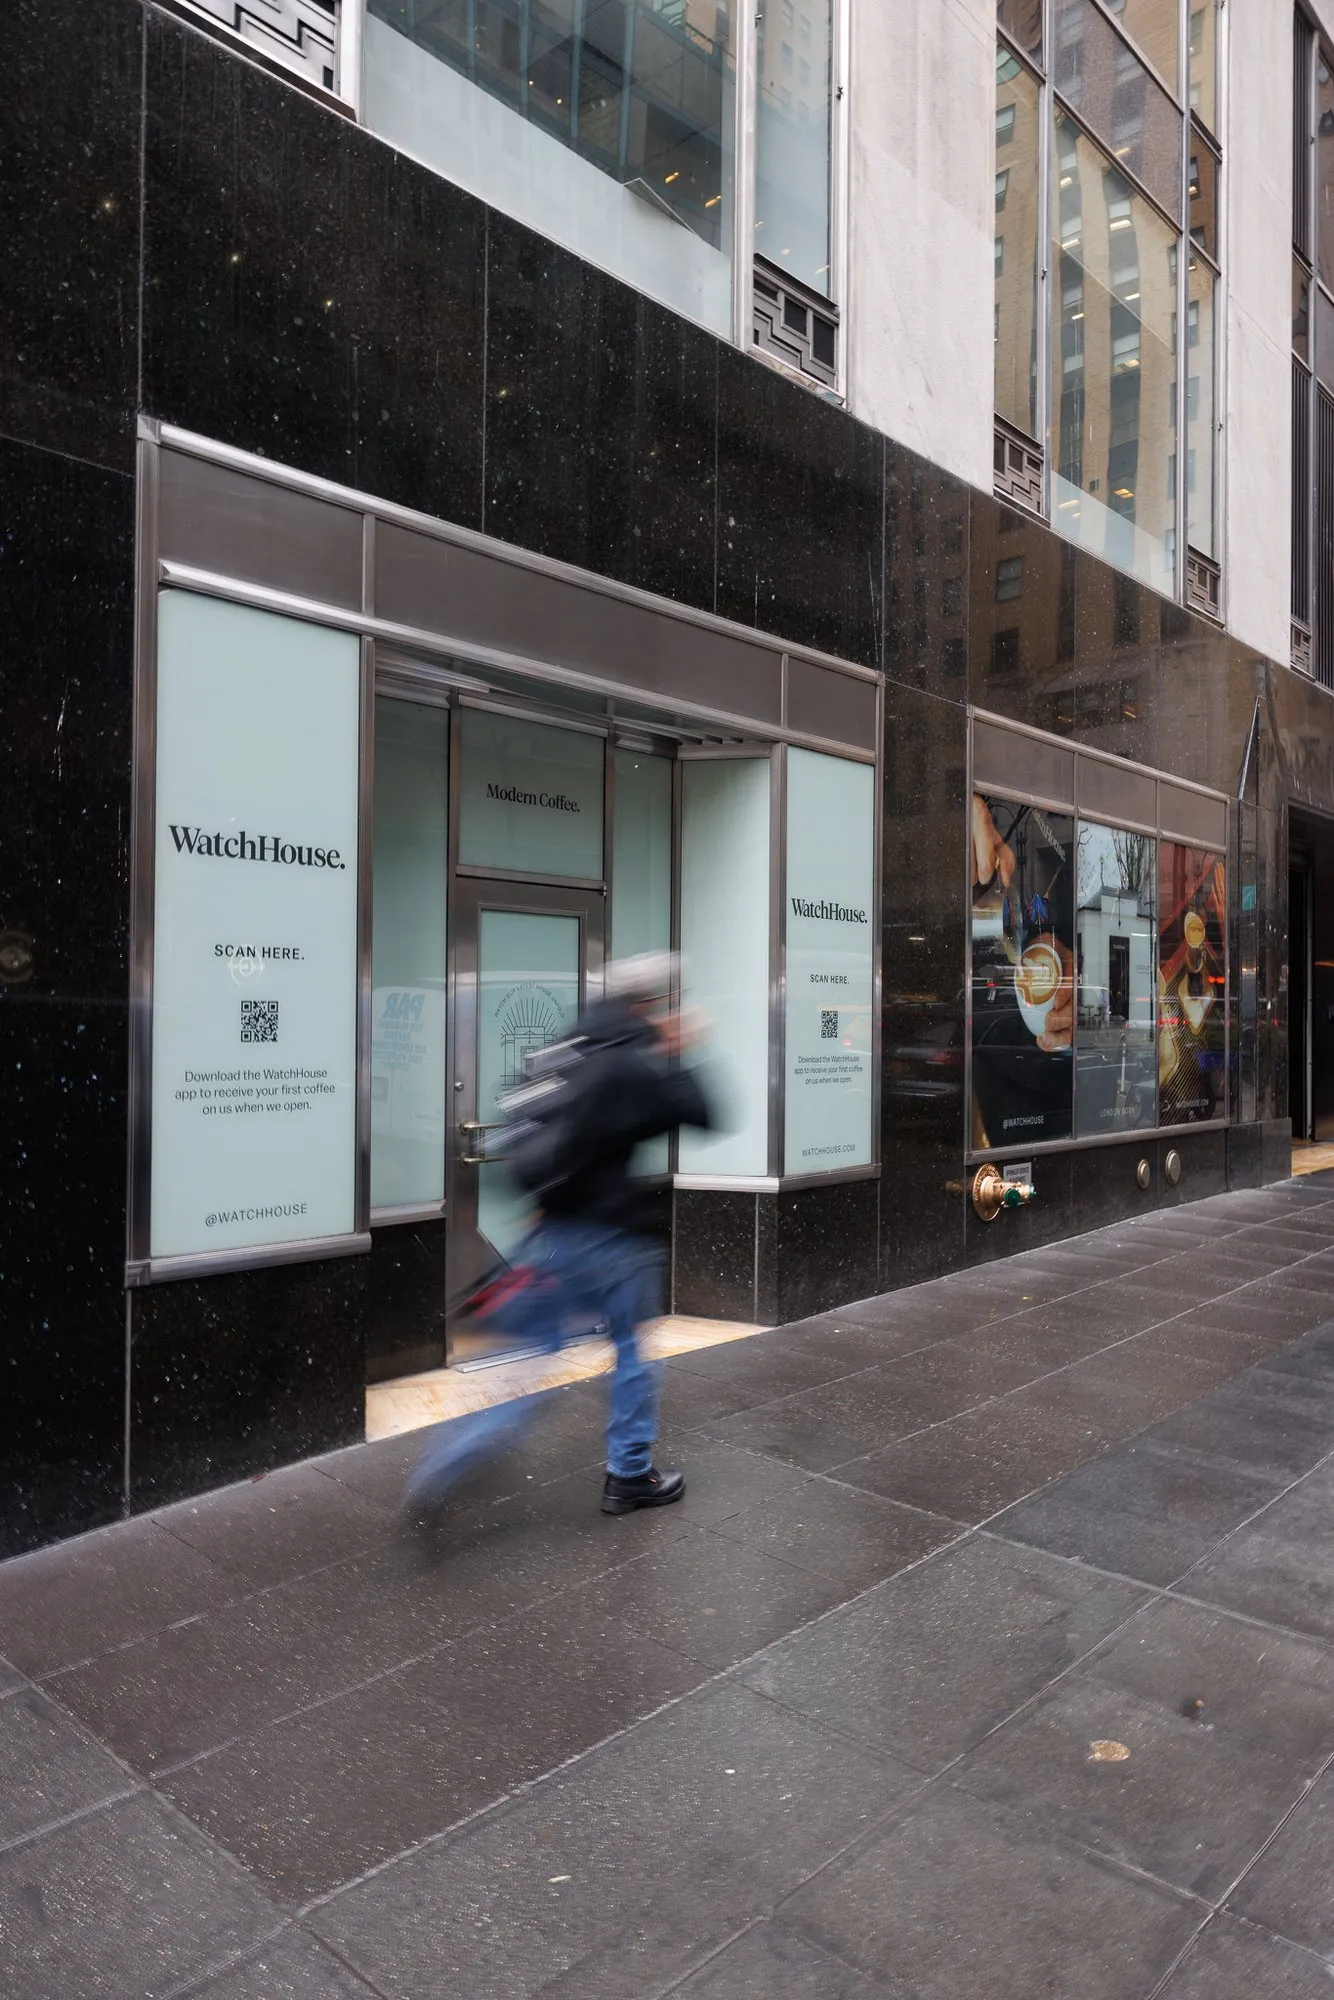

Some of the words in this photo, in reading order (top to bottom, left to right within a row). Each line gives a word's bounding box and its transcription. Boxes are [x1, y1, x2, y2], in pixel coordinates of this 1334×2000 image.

[487, 783, 537, 805] Modern
[539, 793, 580, 813] Coffee.
[168, 824, 346, 870] WatchHouse.
[791, 898, 868, 924] WatchHouse.
[214, 944, 256, 958] SCAN
[262, 946, 305, 960] HERE.
[810, 974, 829, 983] SCAN
[830, 975, 850, 984] HERE.
[798, 1055, 822, 1063] Download
[822, 1055, 831, 1063] the
[184, 1070, 240, 1083] Download
[243, 1069, 261, 1081] the
[263, 1068, 328, 1080] WatchHouse
[828, 1067, 838, 1075] your
[174, 1088, 197, 1101] app
[199, 1087, 212, 1099] to
[214, 1086, 254, 1098] receive
[255, 1086, 279, 1099] your
[281, 1084, 301, 1096] first
[303, 1083, 336, 1095] coffee
[202, 1105, 217, 1115] on
[219, 1104, 232, 1114] us
[234, 1102, 264, 1114] when
[266, 1102, 282, 1112] we
[283, 1101, 312, 1113] open.
[1003, 1115, 1045, 1130] @WATCHHOUSE
[801, 1144, 856, 1157] WATCHHOUSE.COM
[205, 1203, 308, 1228] @WATCHHOUSE
